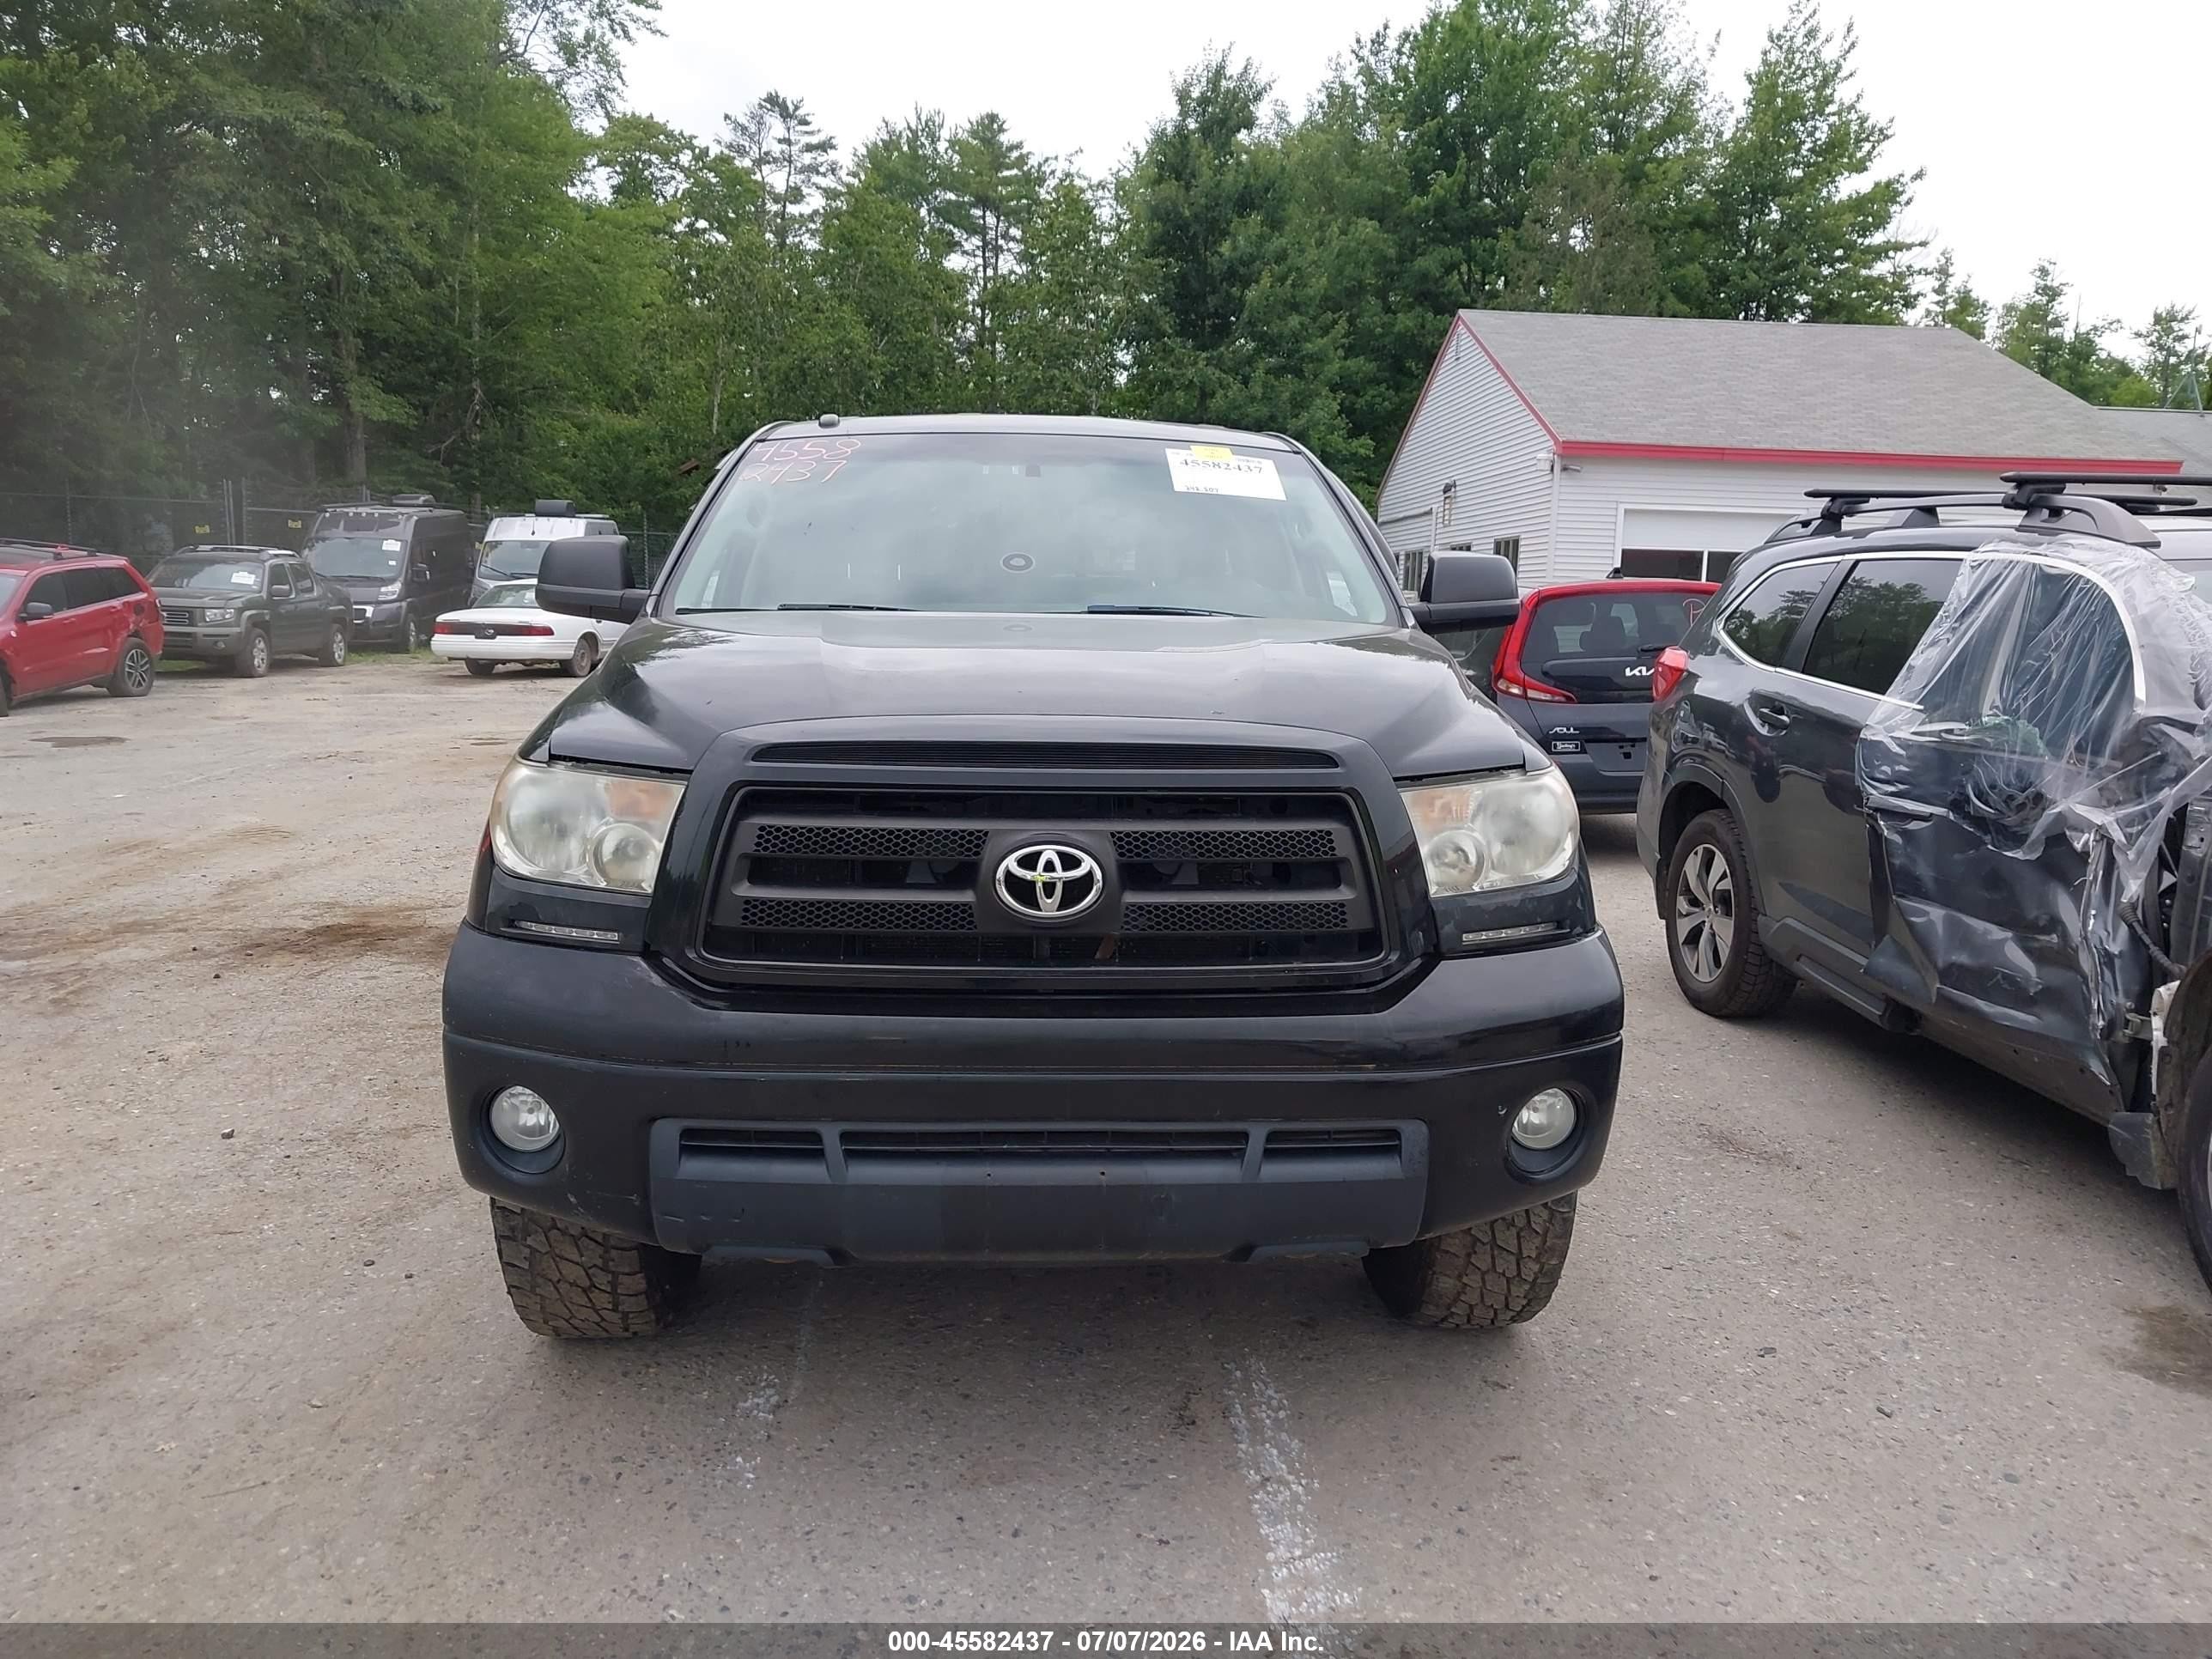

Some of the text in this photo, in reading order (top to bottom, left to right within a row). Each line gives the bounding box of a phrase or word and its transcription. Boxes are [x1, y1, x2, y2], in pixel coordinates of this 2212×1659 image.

[755, 439, 861, 461] 4558
[739, 459, 847, 484] 2437
[1180, 459, 1262, 474] 45582437
